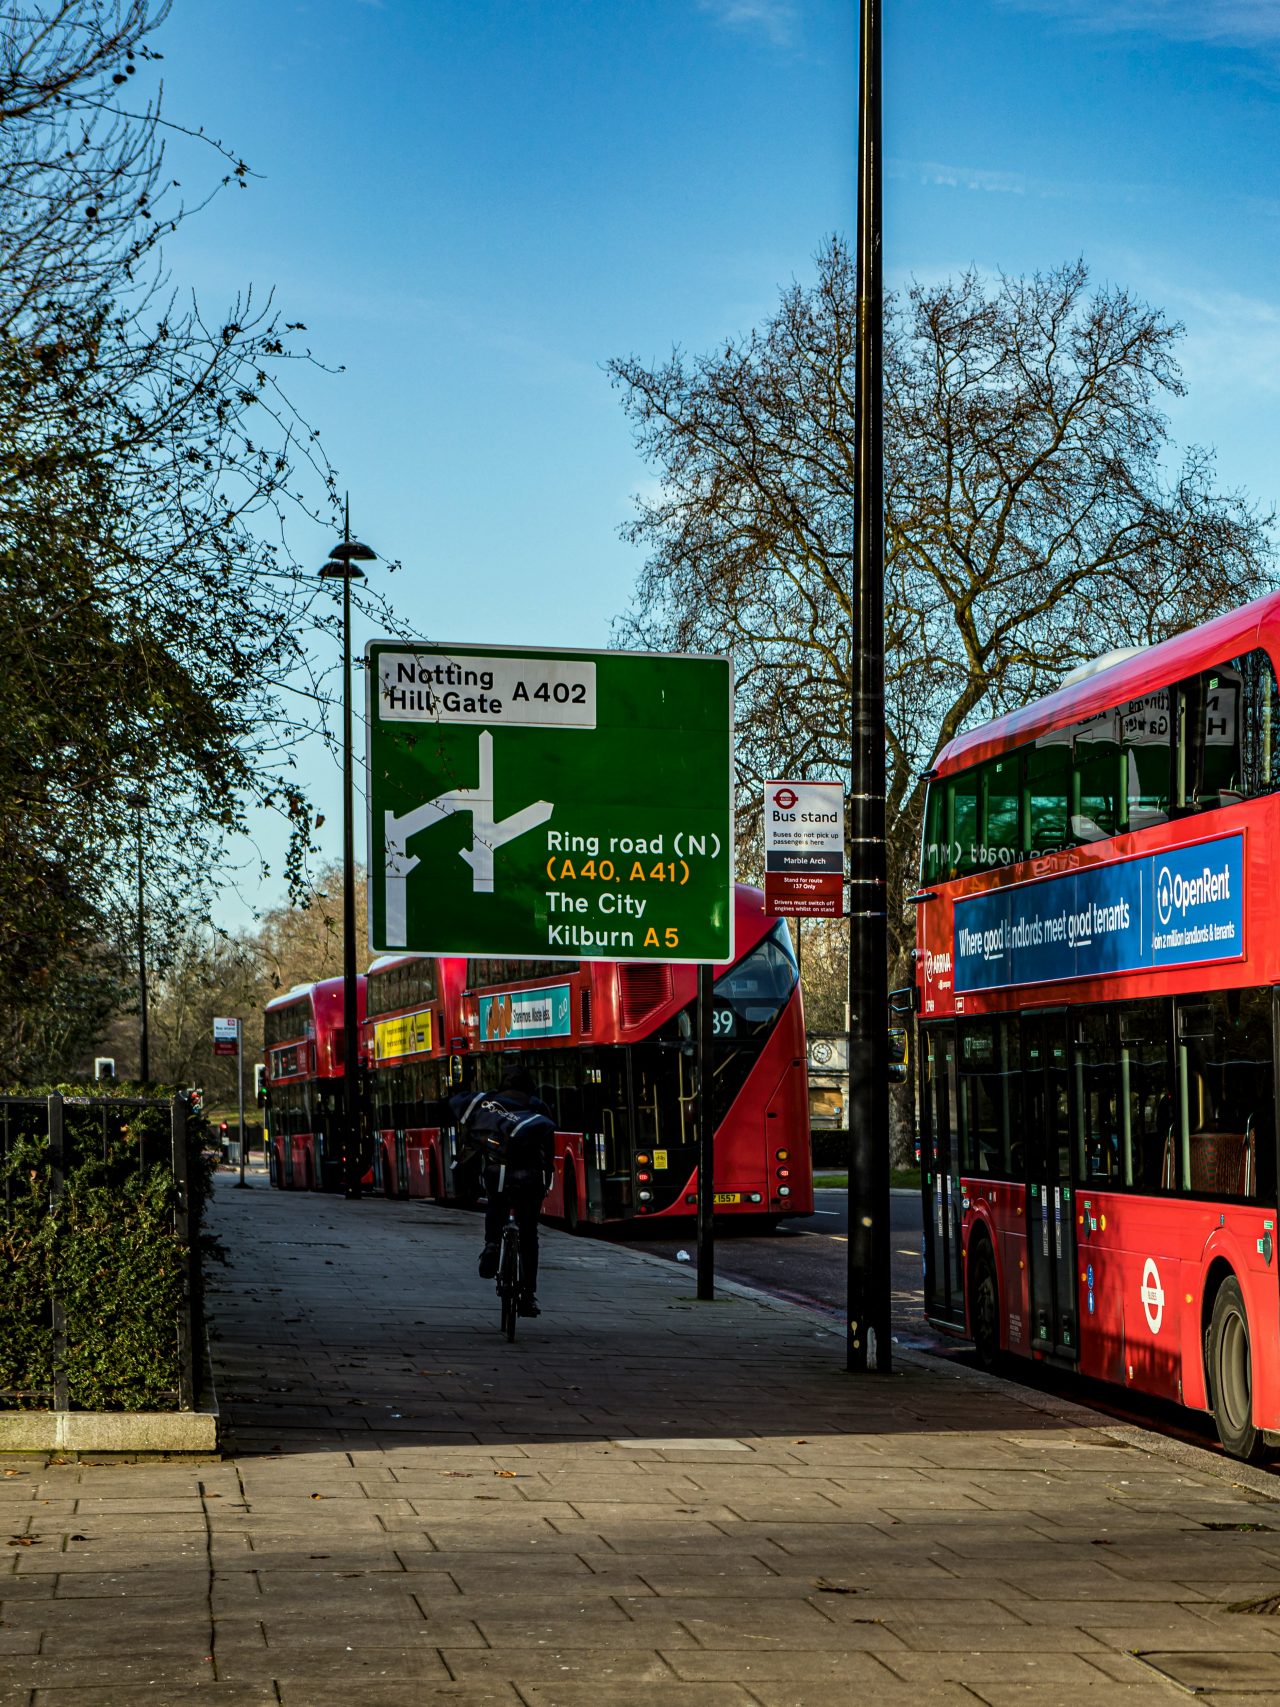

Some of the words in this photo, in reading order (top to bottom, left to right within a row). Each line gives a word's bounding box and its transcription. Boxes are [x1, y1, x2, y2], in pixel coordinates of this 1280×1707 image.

[397, 662, 494, 690] Notting
[390, 689, 431, 710] Hill
[443, 691, 503, 713] Gate
[512, 681, 587, 704] A402
[772, 810, 796, 822] Bus
[801, 811, 838, 823] stand
[547, 831, 599, 857] Ring
[609, 834, 663, 854] road
[673, 832, 721, 858] (N)
[816, 831, 829, 839] pick
[546, 856, 621, 883] (A40,
[629, 859, 690, 886] A41)
[809, 857, 826, 865] Arch
[1174, 863, 1231, 917] OpenRent
[545, 891, 589, 913] The
[598, 893, 647, 919] City
[548, 924, 634, 947] Kilburn
[643, 927, 679, 948] A5
[959, 927, 983, 958] Where
[984, 919, 1004, 961] good
[1044, 909, 1067, 943] meet
[1068, 902, 1092, 948] good
[1093, 896, 1131, 934] tenants
[1214, 920, 1236, 940] tenants
[713, 1010, 733, 1034] 39
